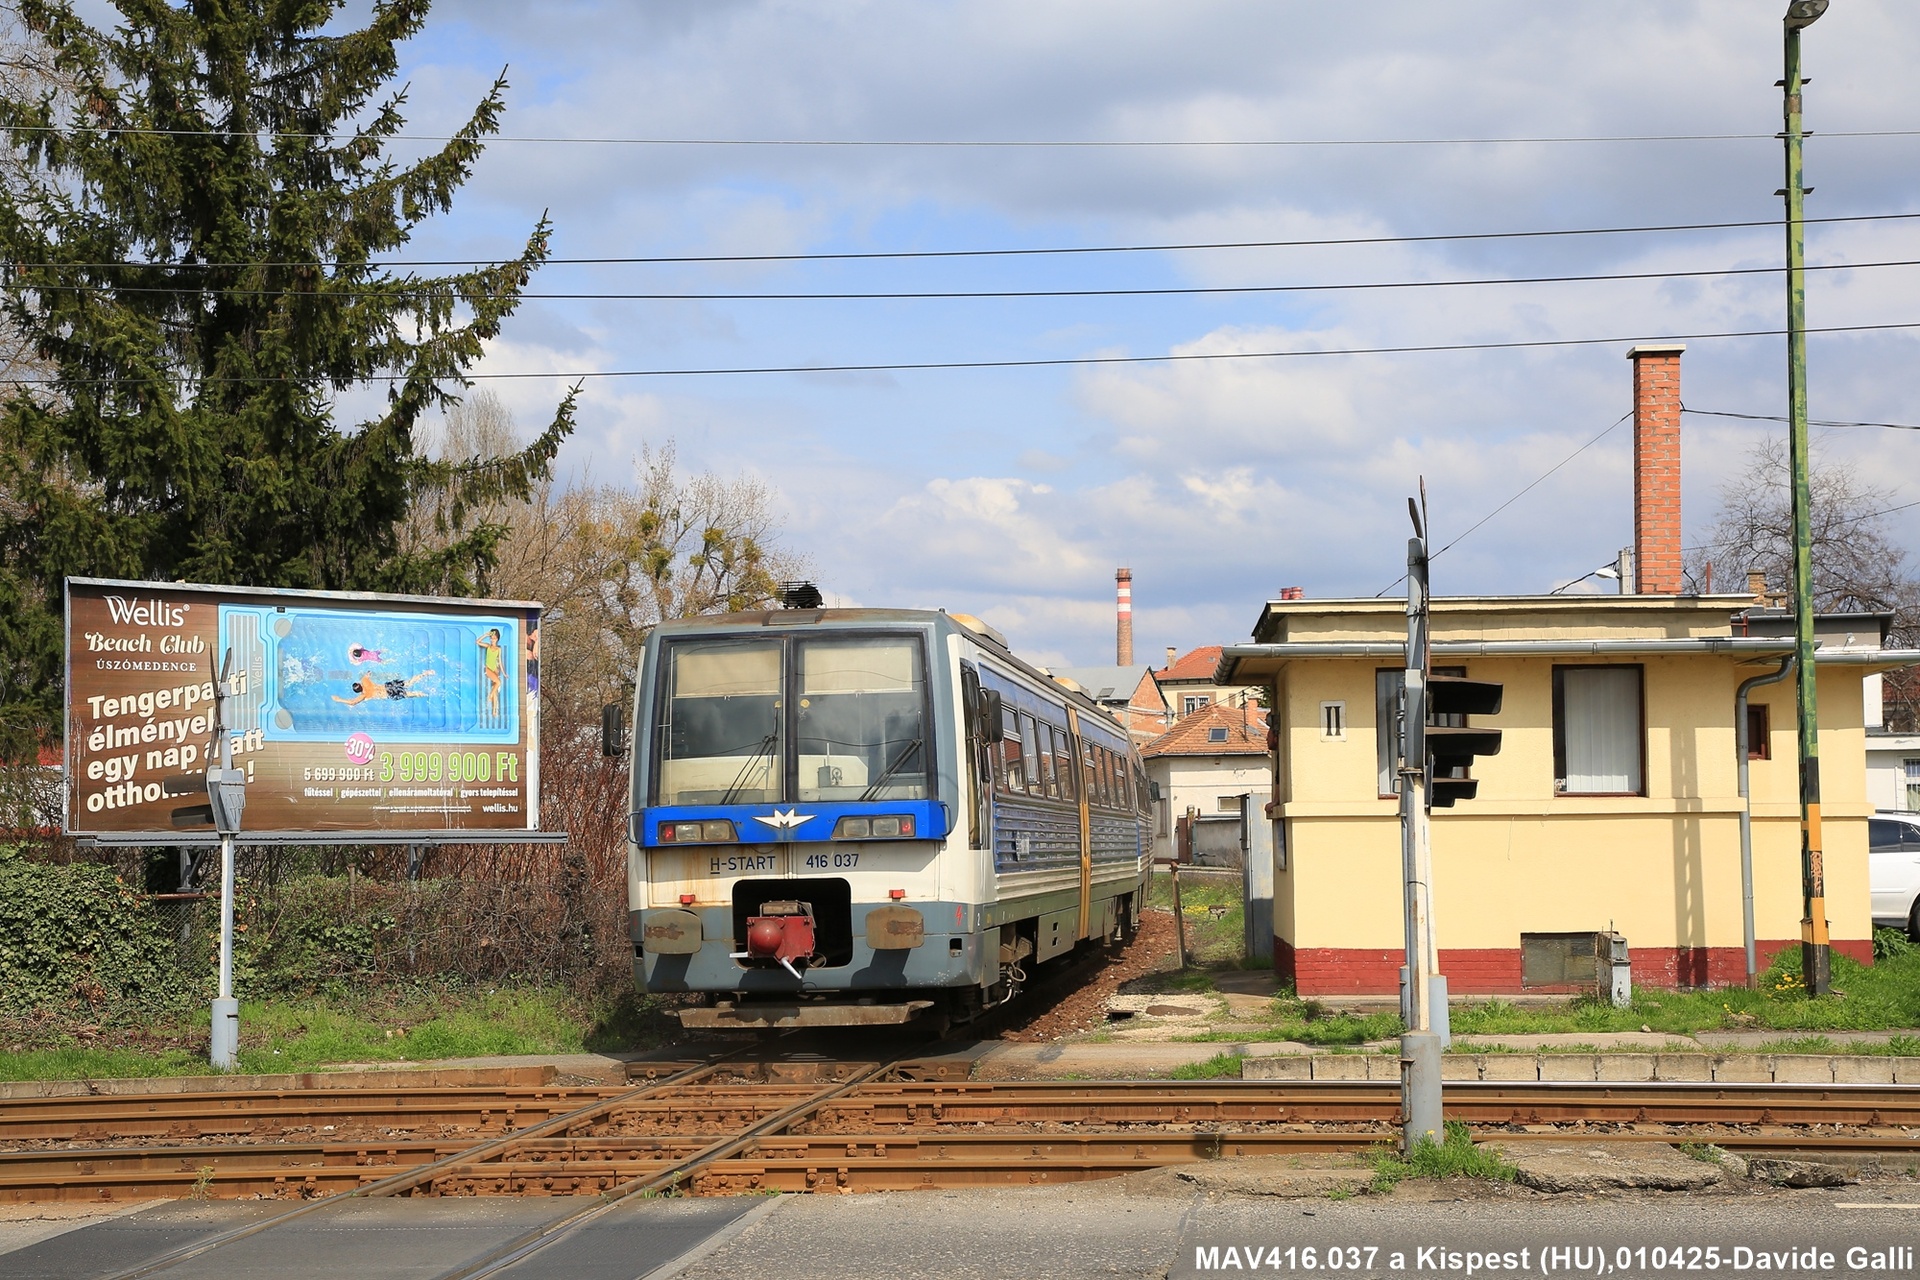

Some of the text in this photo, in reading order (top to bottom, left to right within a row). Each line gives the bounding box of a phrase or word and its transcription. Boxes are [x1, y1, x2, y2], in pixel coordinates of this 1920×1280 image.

[84, 632, 205, 654] Beach Club
[96, 658, 197, 672] ÚSZÓMEDENCE
[87, 670, 248, 720] Tengerpati
[1324, 706, 1341, 736] II
[87, 727, 265, 783] egy nap aatt
[344, 738, 374, 760] -30%
[304, 767, 375, 781] 5 699 900 Ft
[380, 752, 519, 782] 3 999 900 Ft
[460, 788, 480, 799] gyors
[482, 803, 519, 813] wellis.hu
[710, 856, 776, 873] H-START
[806, 853, 860, 869] 416 037
